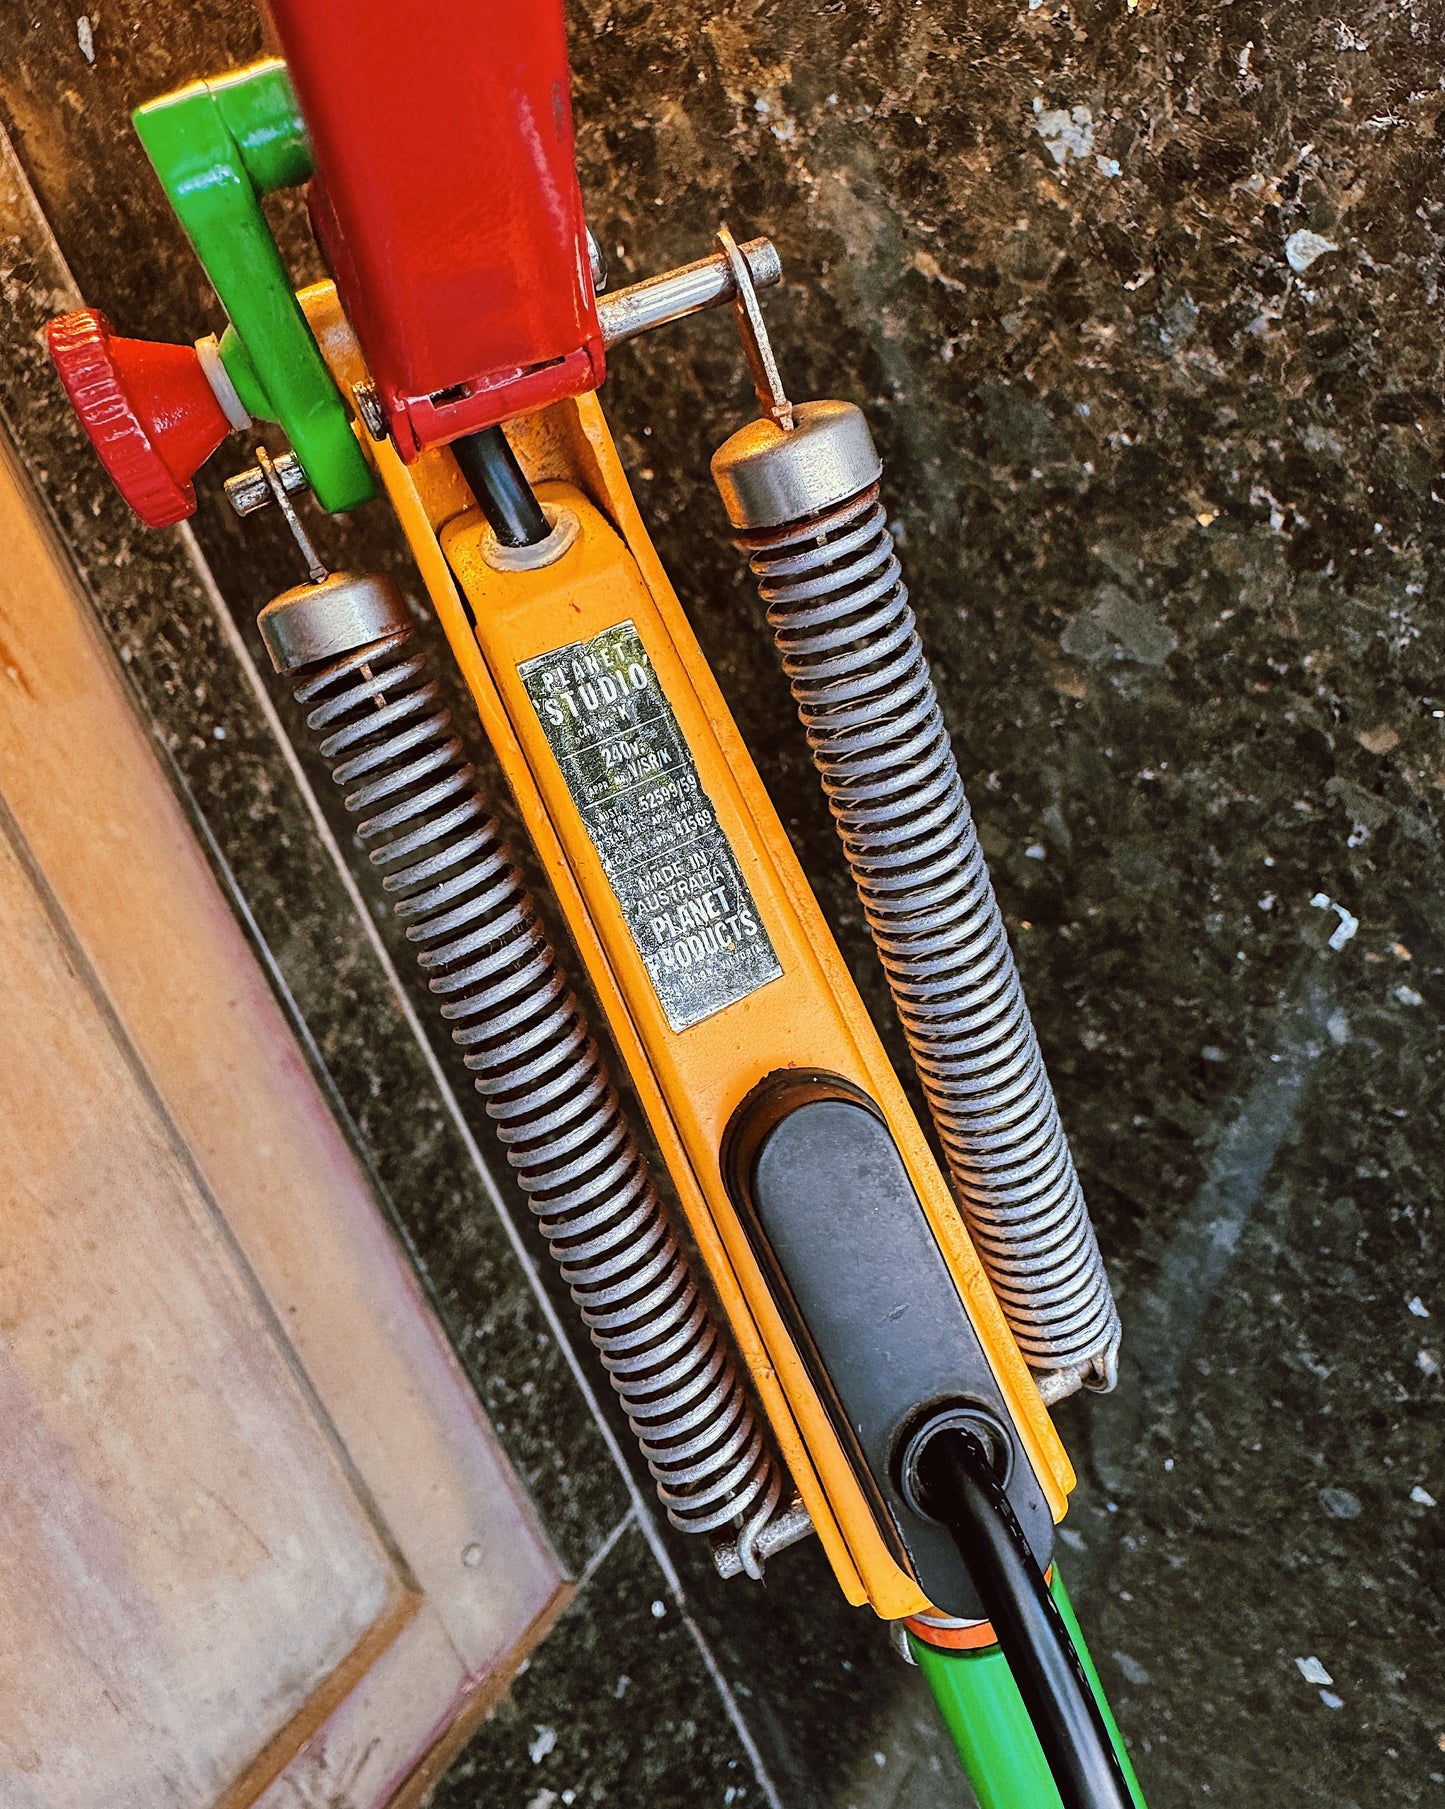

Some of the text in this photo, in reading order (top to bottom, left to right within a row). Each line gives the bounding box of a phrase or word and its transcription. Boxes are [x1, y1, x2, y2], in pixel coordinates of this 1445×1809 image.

[540, 643, 627, 693] PLANET
[627, 747, 672, 777] V/SR/K
[638, 774, 698, 811] 52599/59
[674, 809, 712, 836] 41569
[637, 850, 708, 893] MADE IN
[637, 866, 724, 915] AUSTRALIA
[649, 886, 730, 943] PLANET
[644, 909, 758, 980] PRODUCTS
